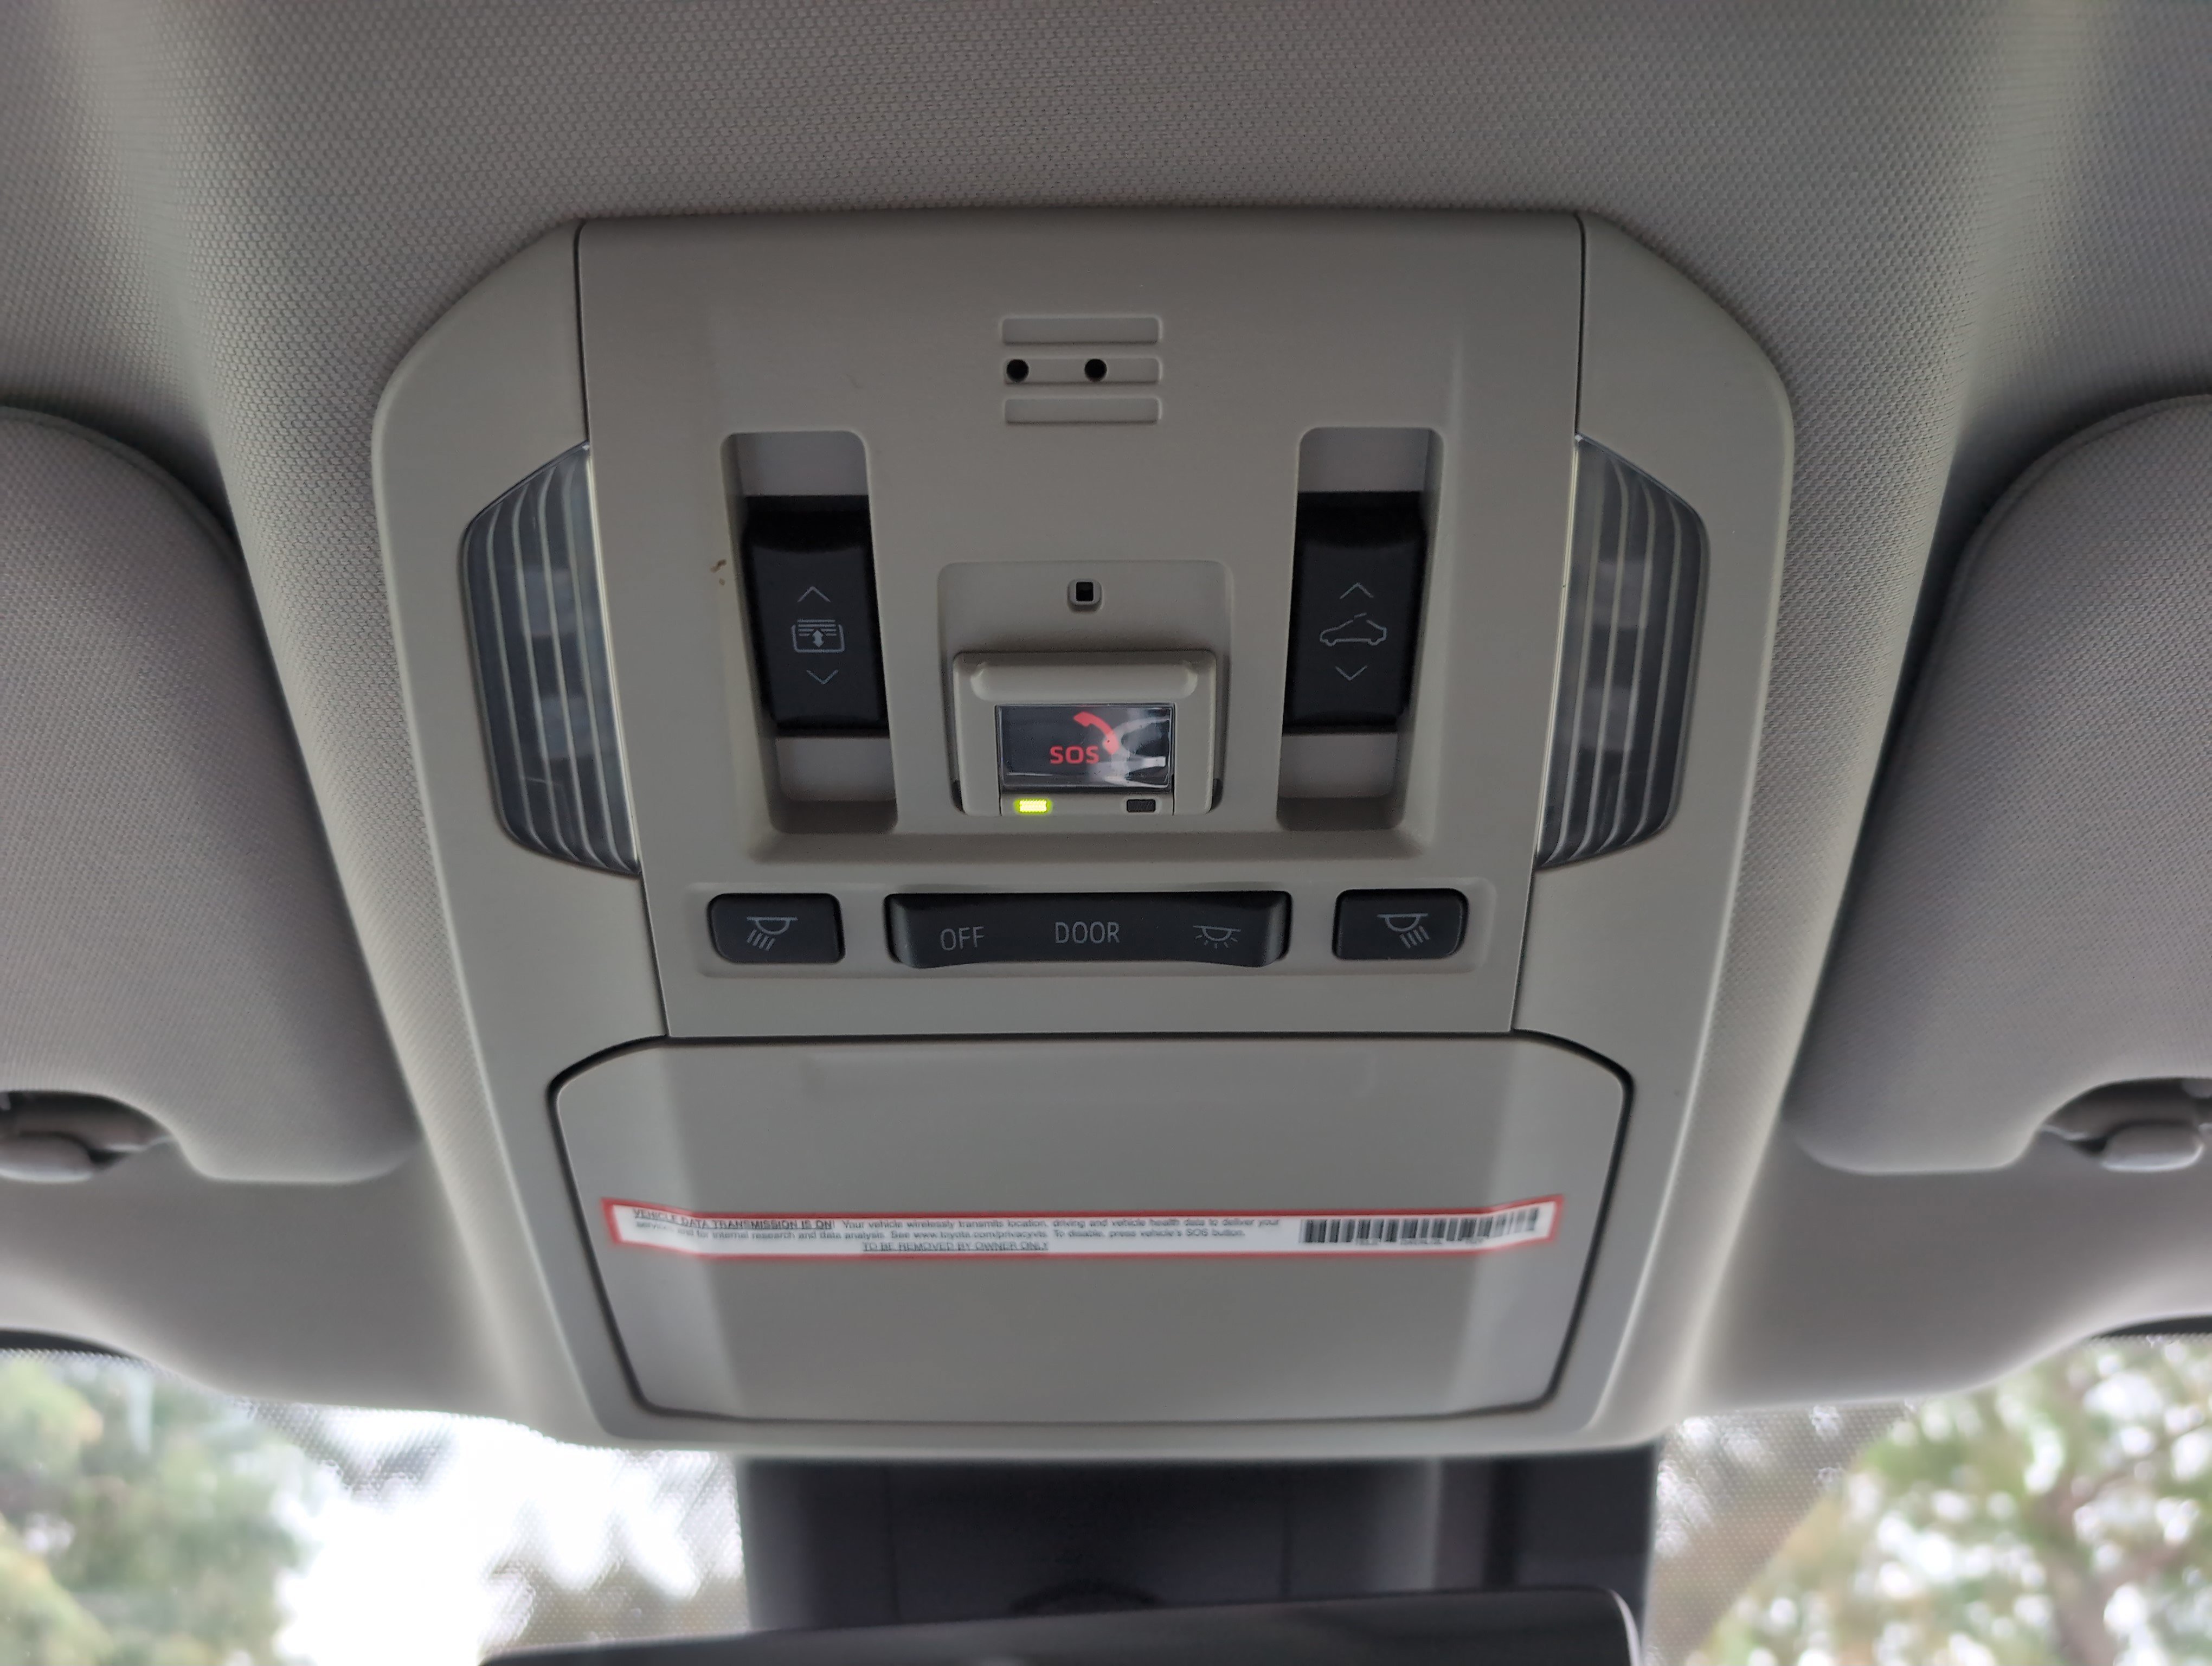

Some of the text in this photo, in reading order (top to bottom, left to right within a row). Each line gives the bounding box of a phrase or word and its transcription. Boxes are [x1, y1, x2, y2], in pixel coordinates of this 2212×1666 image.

[1050, 745, 1099, 765] SOS
[941, 926, 985, 951] OFF
[1055, 921, 1120, 945] DOOR
[681, 1216, 706, 1229] DATA
[712, 1219, 798, 1229] TRANSMISSION
[842, 1220, 863, 1228] Your
[906, 1219, 953, 1229] wirelessly
[959, 1219, 1003, 1227] transmits
[1209, 1218, 1218, 1226] to
[1258, 1219, 1279, 1227] your
[712, 1231, 748, 1239] internal
[752, 1231, 795, 1239] research
[891, 1230, 910, 1238] See
[1054, 1229, 1065, 1238] To
[1186, 1228, 1208, 1236] SOS
[862, 1241, 1049, 1251] TO BE REMOVED BY OWNER ONLY
